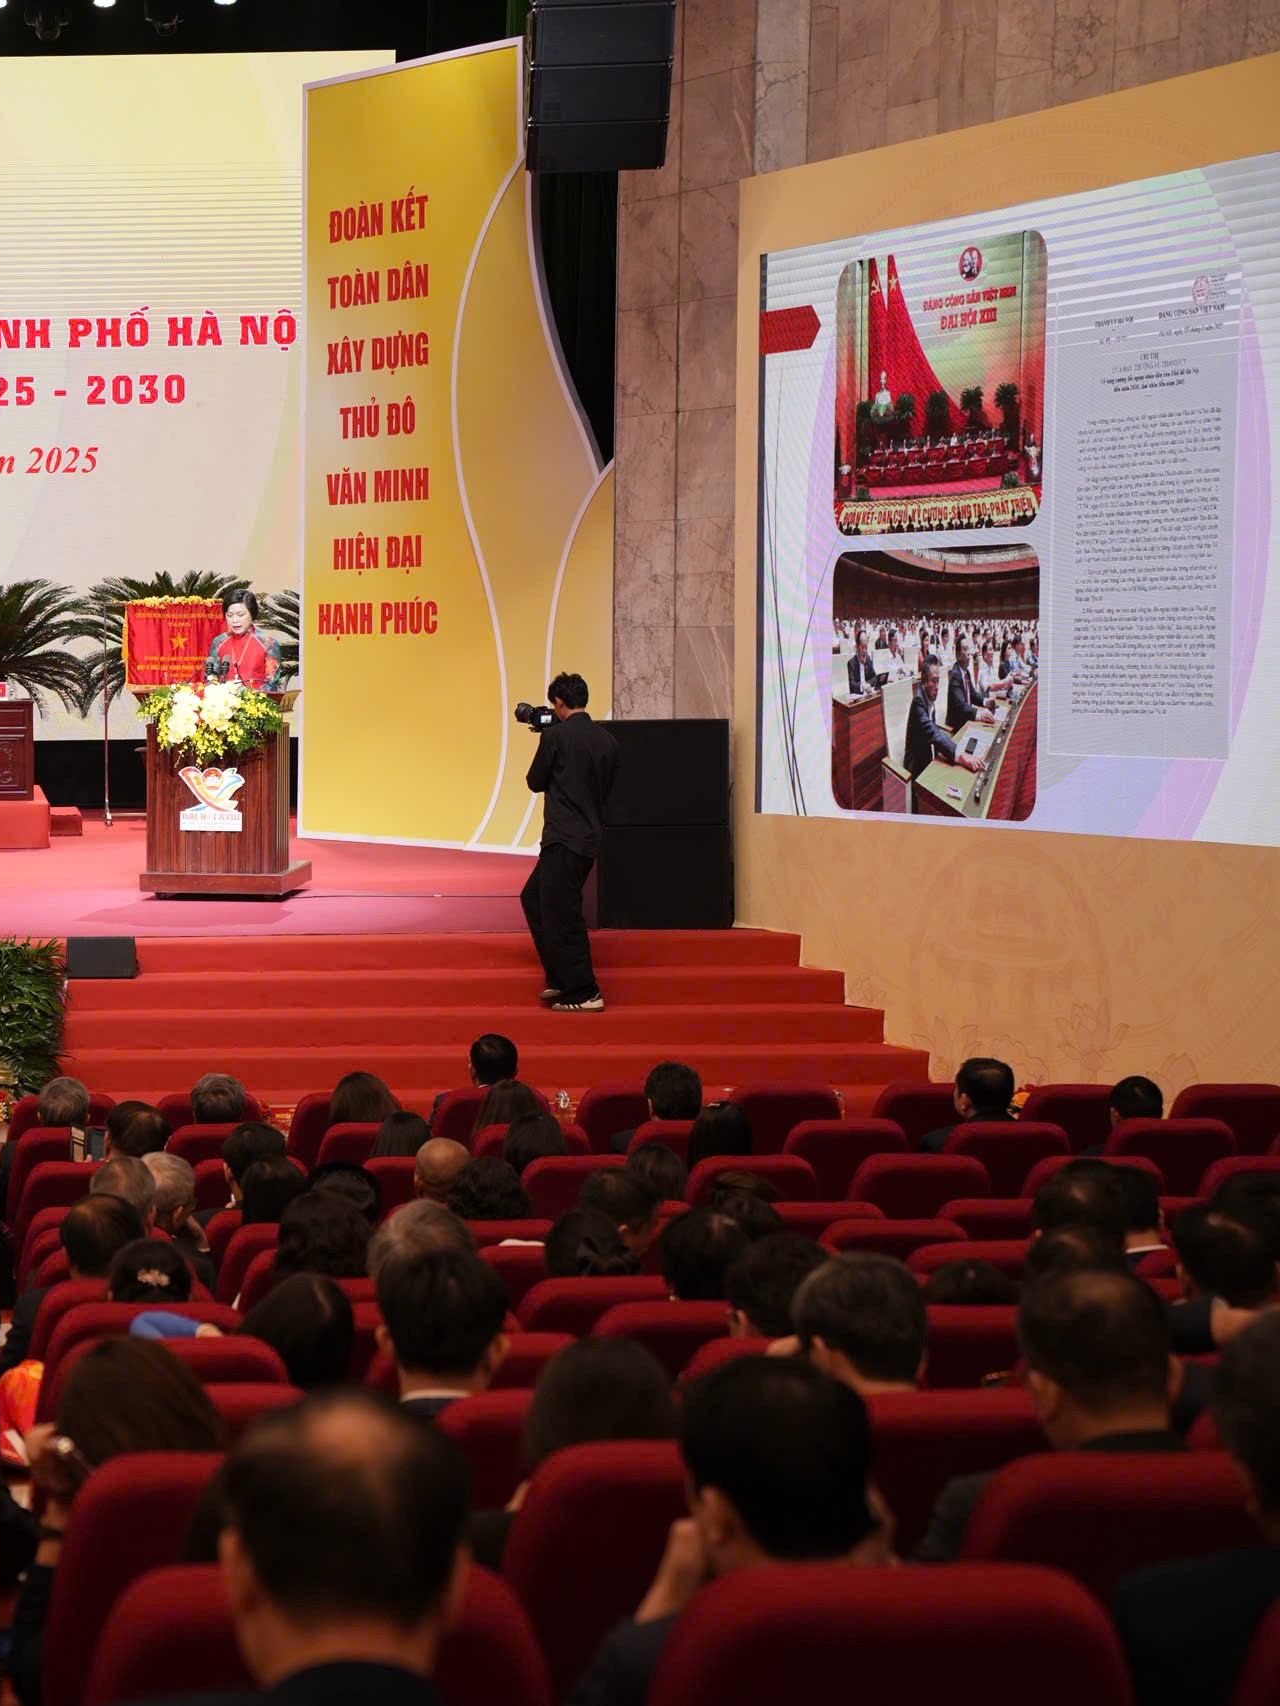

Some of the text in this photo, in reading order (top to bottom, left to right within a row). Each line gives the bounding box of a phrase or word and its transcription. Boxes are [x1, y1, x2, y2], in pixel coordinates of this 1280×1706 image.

[328, 185, 428, 244] ĐOÀN KẾT
[327, 260, 428, 310] TOÀN DÂN
[68, 305, 150, 349] PHỐ
[167, 309, 223, 347] HÀ
[239, 308, 298, 352] NỘ
[327, 329, 429, 376] XÂY DỰNG
[87, 373, 186, 406] 2030
[339, 395, 416, 440] THỦ ĐÔ
[25, 446, 99, 474] 2025
[326, 467, 430, 506] VĂN MINH
[333, 531, 422, 576] HIỆN ĐẠI
[318, 596, 438, 641] HẠNH PHÚC
[200, 813, 217, 821] HI
